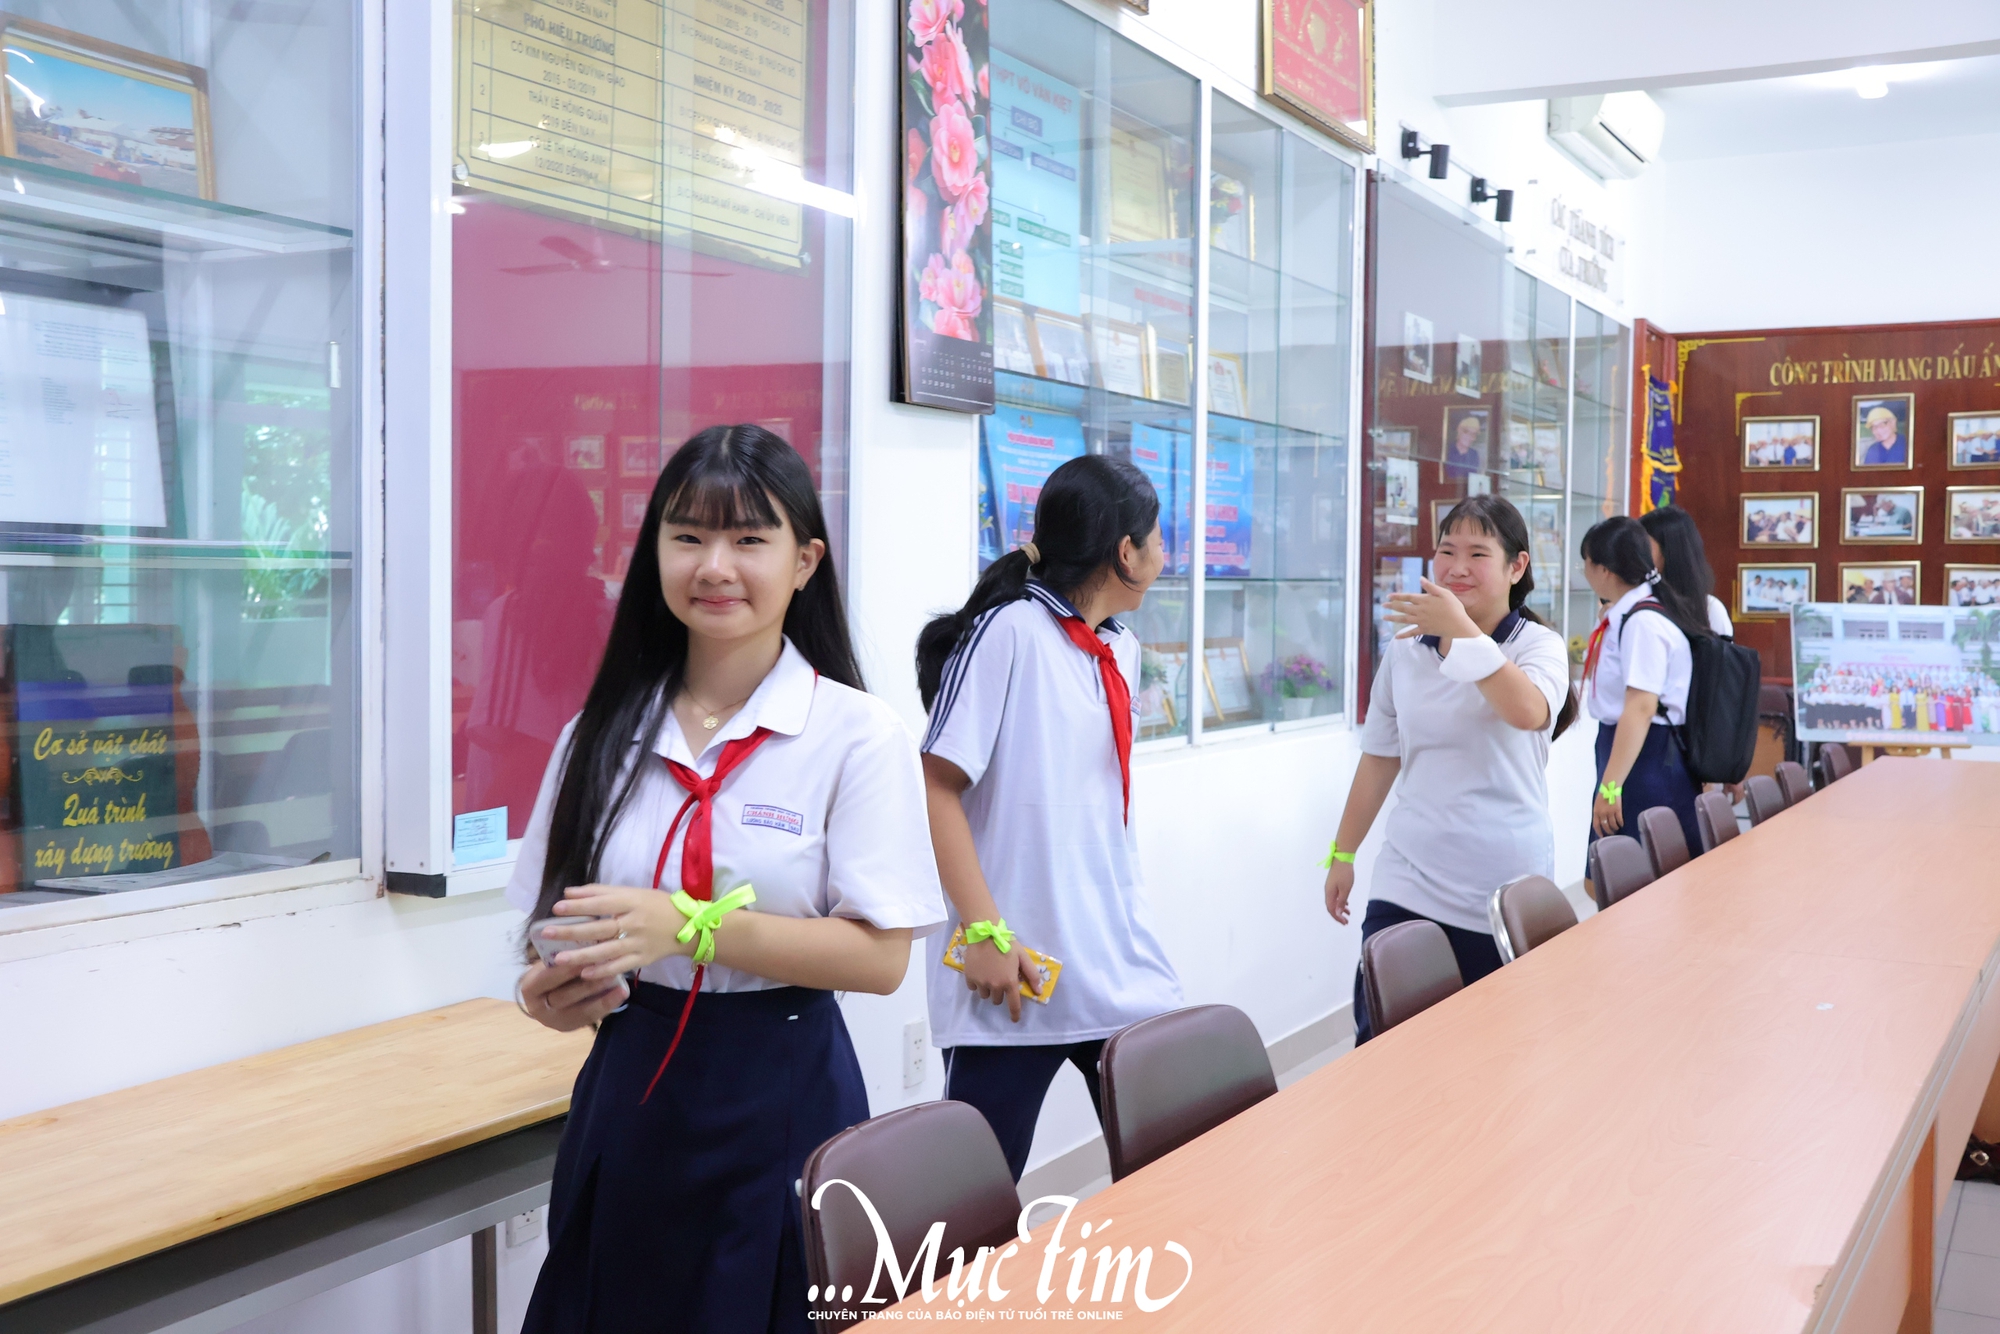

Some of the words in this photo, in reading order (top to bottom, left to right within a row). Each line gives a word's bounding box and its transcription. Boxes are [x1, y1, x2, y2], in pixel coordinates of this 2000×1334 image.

[524, 12, 545, 31] PHÓ
[549, 21, 573, 42] HIỆU
[576, 31, 615, 55] TRƯỞNG
[1770, 356, 1818, 386] CÔNG
[1821, 353, 1876, 384] TRÌNH
[1879, 356, 1932, 382] MANG
[1936, 342, 1976, 379] DẤU
[33, 727, 64, 760] Cơ
[66, 729, 88, 755] sở
[93, 733, 123, 762] vật
[129, 728, 167, 754] chất
[63, 793, 99, 826] Quá
[104, 792, 146, 824] trình
[35, 840, 66, 875] xây
[71, 837, 114, 873] dựng
[119, 832, 174, 869] trường
